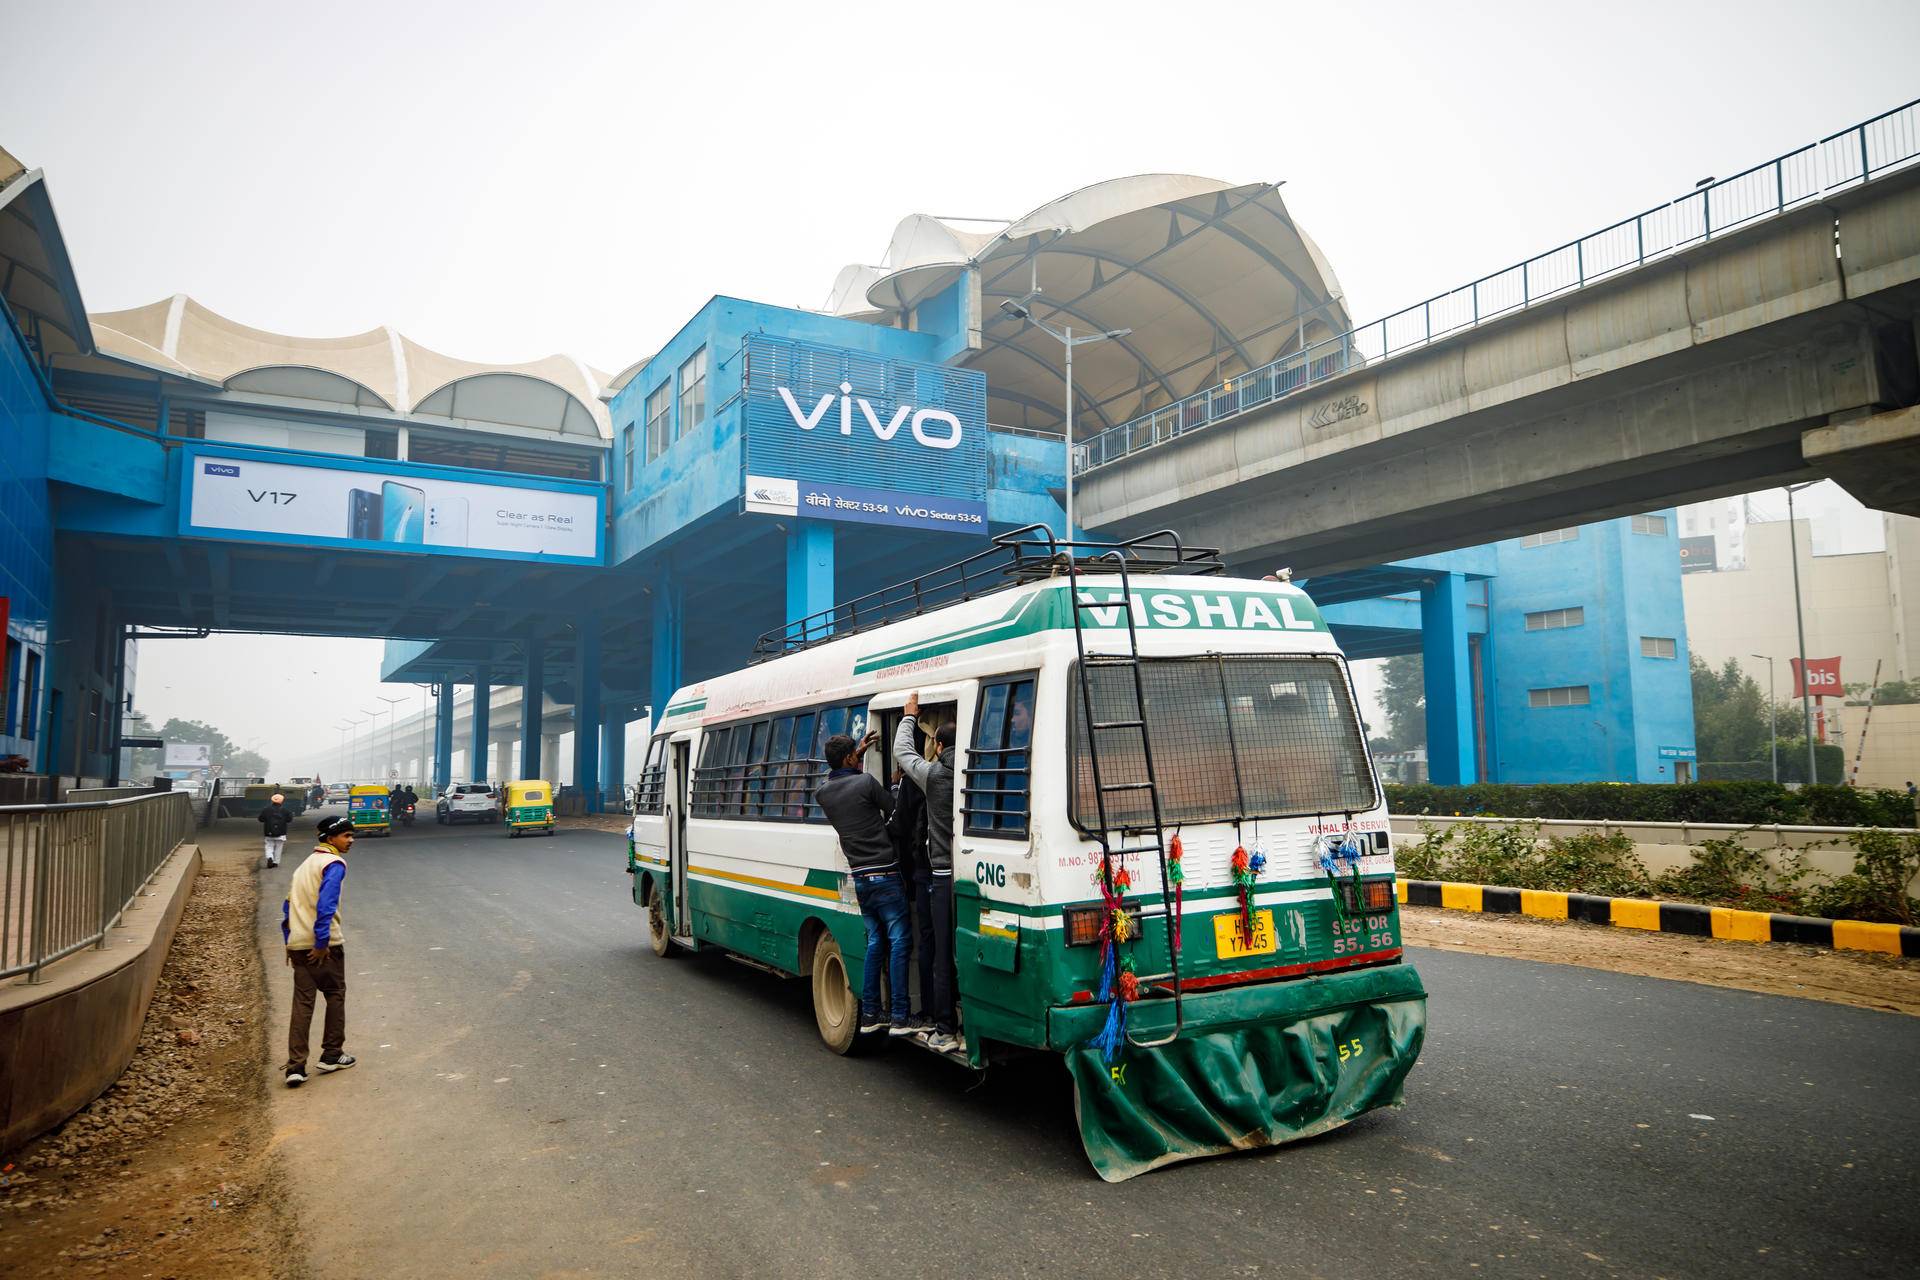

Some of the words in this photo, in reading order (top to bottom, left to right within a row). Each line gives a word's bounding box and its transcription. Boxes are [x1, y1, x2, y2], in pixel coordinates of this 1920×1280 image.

[777, 381, 962, 449] vivo
[210, 466, 234, 474] vivo
[247, 489, 297, 505] V17
[805, 492, 831, 507] वीवो
[834, 496, 860, 511] सेक्टर
[862, 502, 888, 513] 53-54
[496, 510, 528, 519] Clear
[531, 514, 544, 522] as
[547, 514, 573, 524] Real
[895, 505, 928, 518] vivo
[930, 510, 957, 521] Sector
[957, 513, 982, 524] 53-54
[1077, 592, 1315, 630] VISHAL
[1805, 668, 1836, 686] bis
[1308, 824, 1340, 834] VISHAL
[976, 861, 1006, 888] CNG
[1230, 934, 1267, 952] Y745
[1370, 932, 1393, 948] 56
